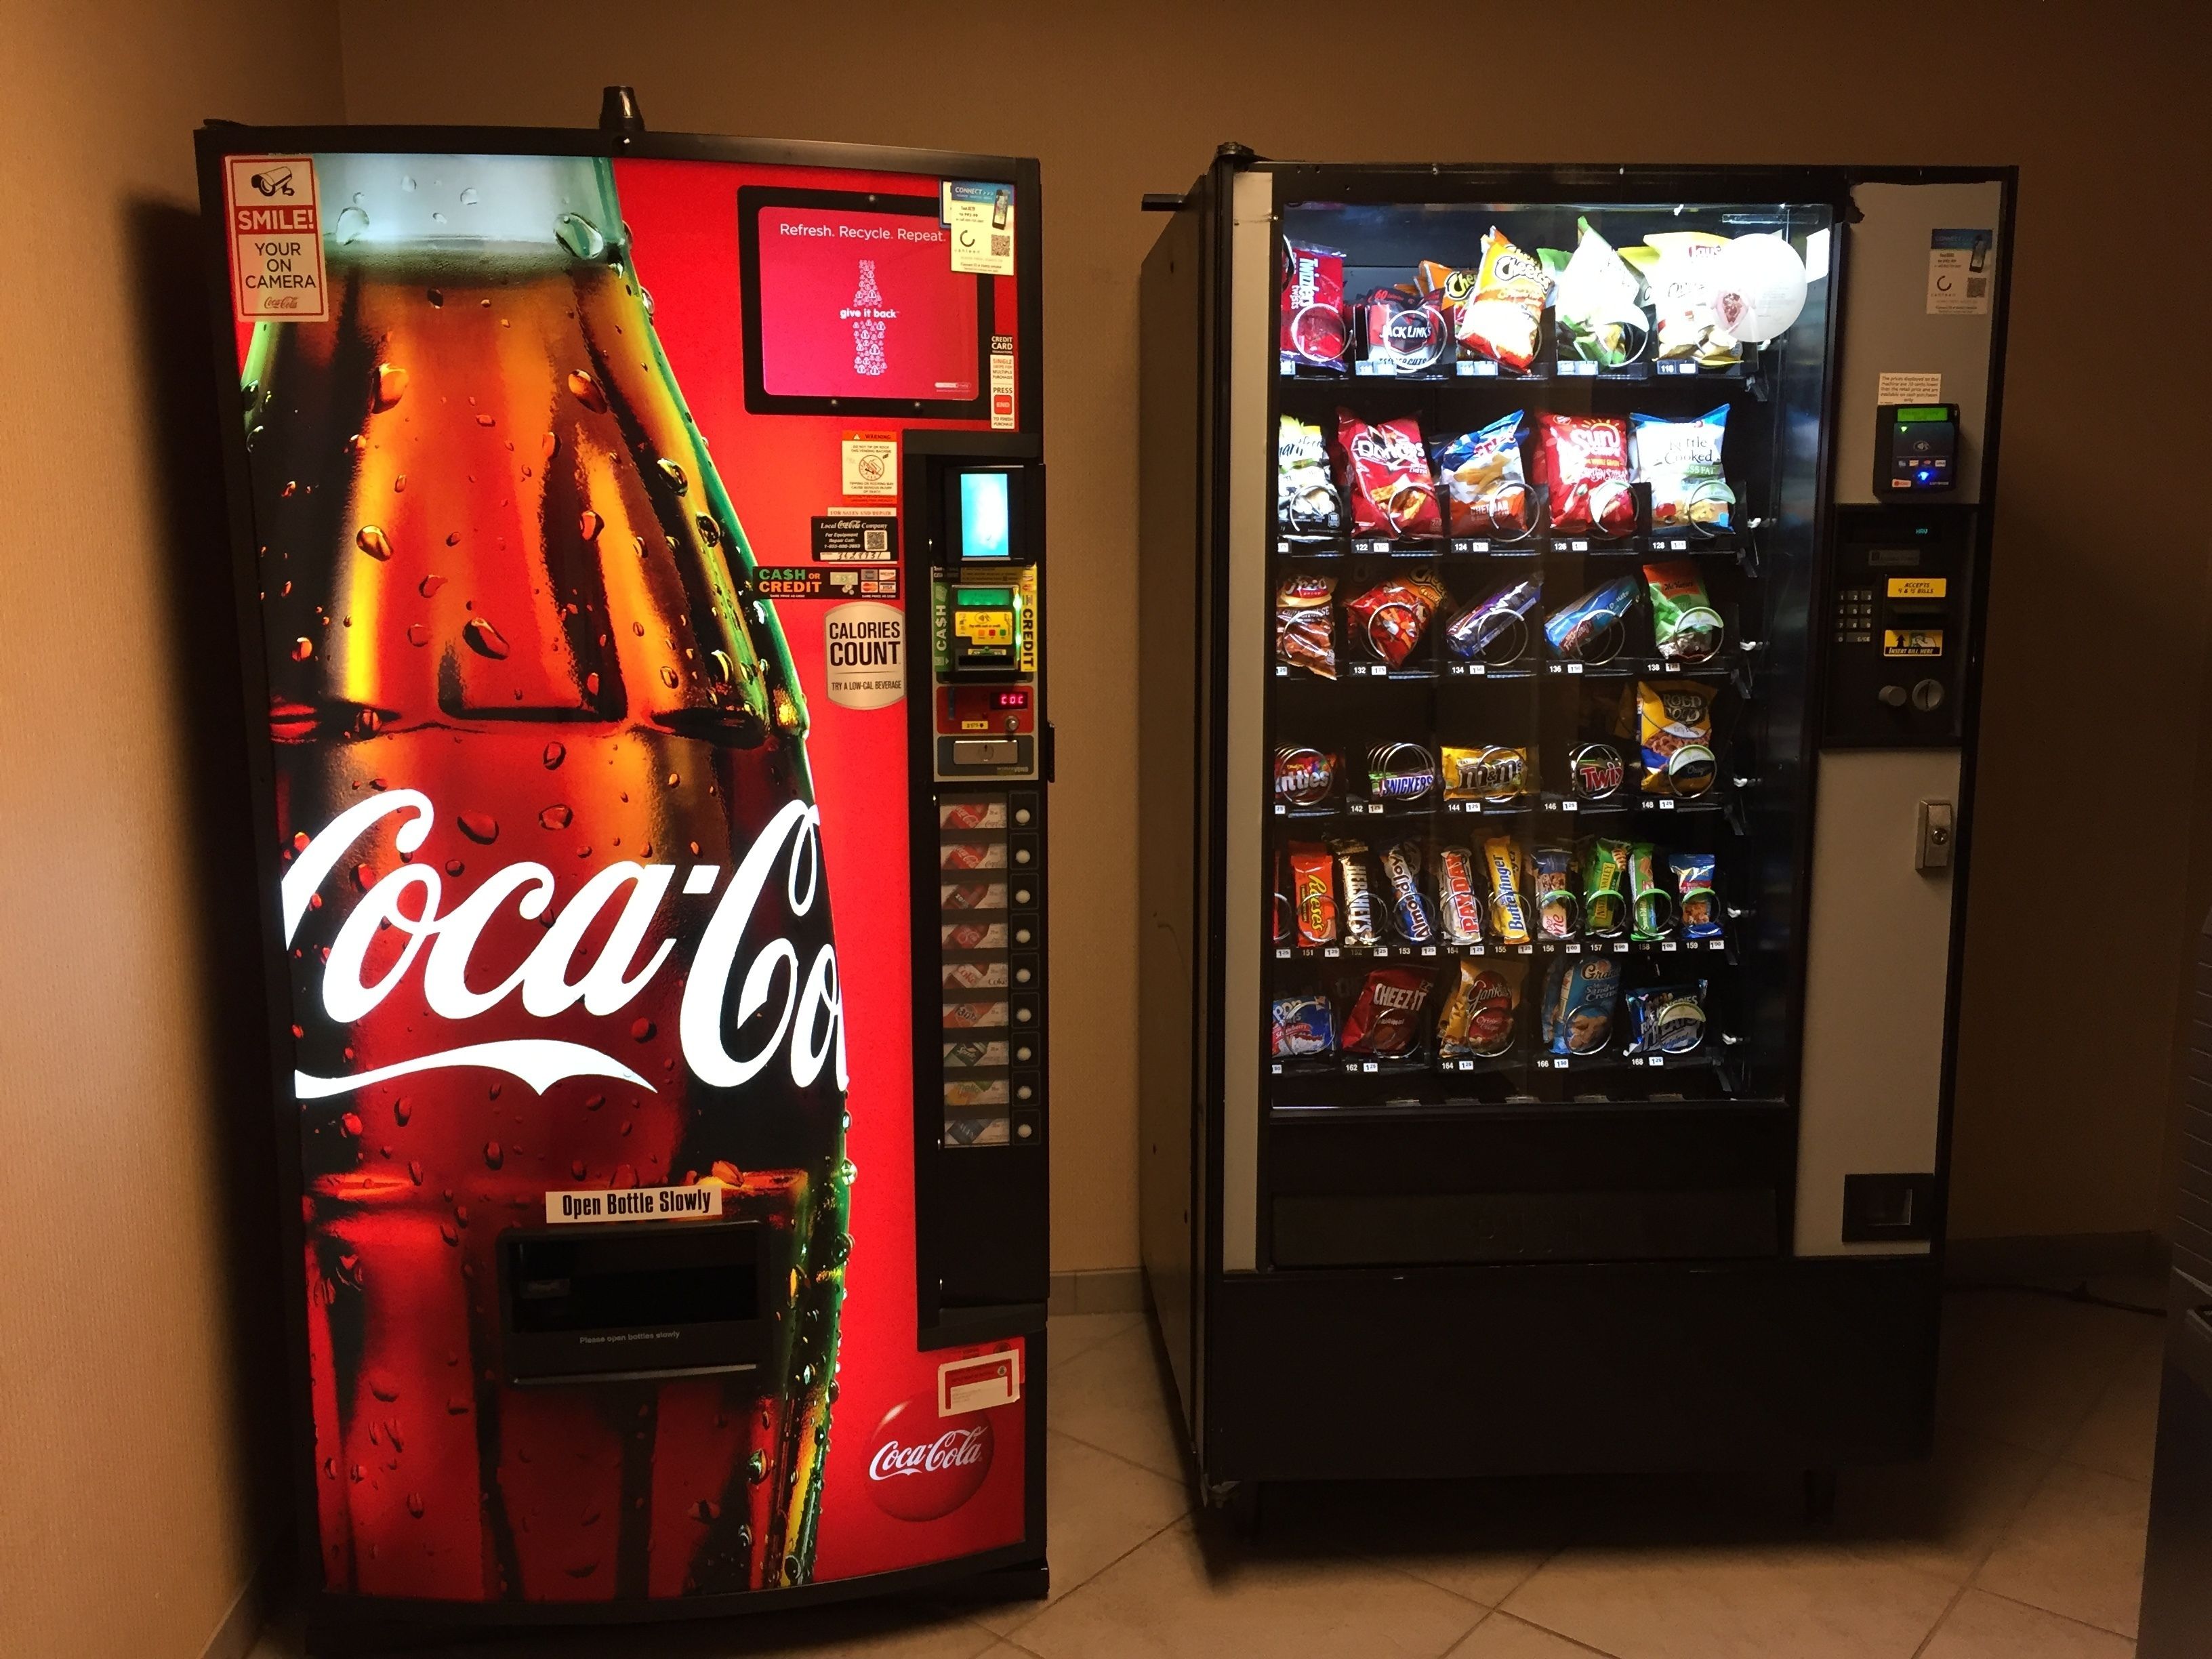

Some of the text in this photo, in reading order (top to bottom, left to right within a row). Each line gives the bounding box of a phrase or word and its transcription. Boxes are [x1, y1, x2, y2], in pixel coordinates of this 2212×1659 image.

[238, 209, 314, 231] SMILE!
[779, 224, 946, 243] Refresh. Recycle. Repeat.
[254, 242, 301, 256] YOUR
[266, 258, 291, 272] ON
[1494, 255, 1552, 294] Cheetos
[245, 275, 316, 289] CAMERA
[840, 308, 897, 319] give it back
[1357, 439, 1427, 464] Doritos
[1570, 428, 1621, 455] Sun
[1664, 449, 1713, 464] Cooked
[1700, 466, 1716, 474] FAT
[861, 523, 887, 531] Company
[759, 581, 822, 592] CREDIT
[830, 621, 901, 640] CALORIES
[1023, 609, 1033, 667] CREDIT
[830, 641, 901, 666] COUNT
[832, 680, 901, 691] TRY A LOW-CAL BEVERAGE
[1382, 775, 1433, 796] SNICKERS
[1601, 863, 1616, 890] VALLEY
[1308, 875, 1327, 931] Reese's
[1445, 852, 1480, 934] PAYDAY
[1492, 854, 1525, 932] Butterfinger
[562, 1189, 711, 1219] Open Bottle Slowly
[579, 1330, 680, 1344] Please open bottles slowly
[869, 1425, 988, 1481] Coca-Cola
